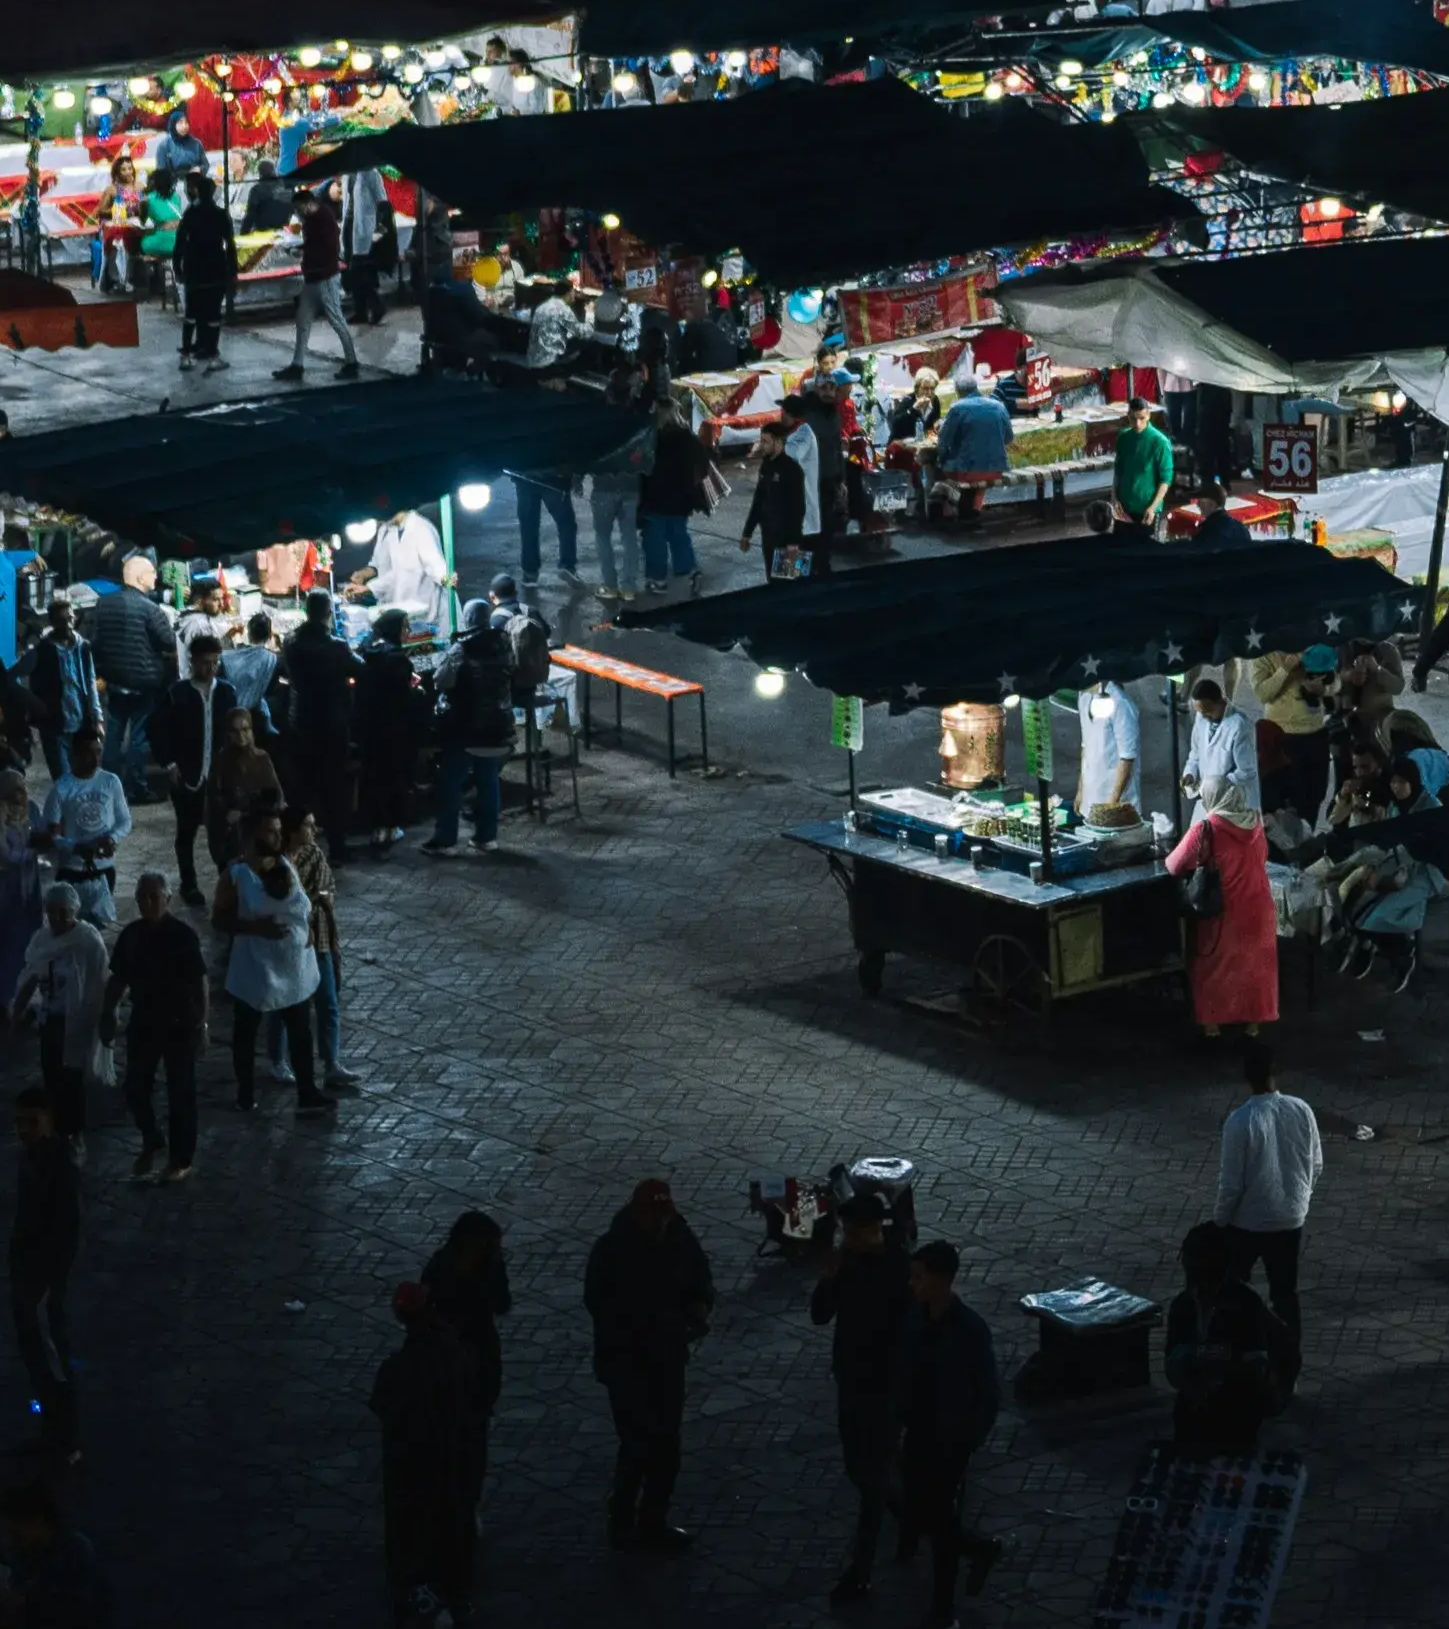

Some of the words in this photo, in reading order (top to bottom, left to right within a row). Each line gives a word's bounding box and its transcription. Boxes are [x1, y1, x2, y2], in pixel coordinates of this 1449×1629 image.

[637, 269, 653, 287] 52
[1034, 358, 1051, 390] 56
[1269, 440, 1312, 478] 56
